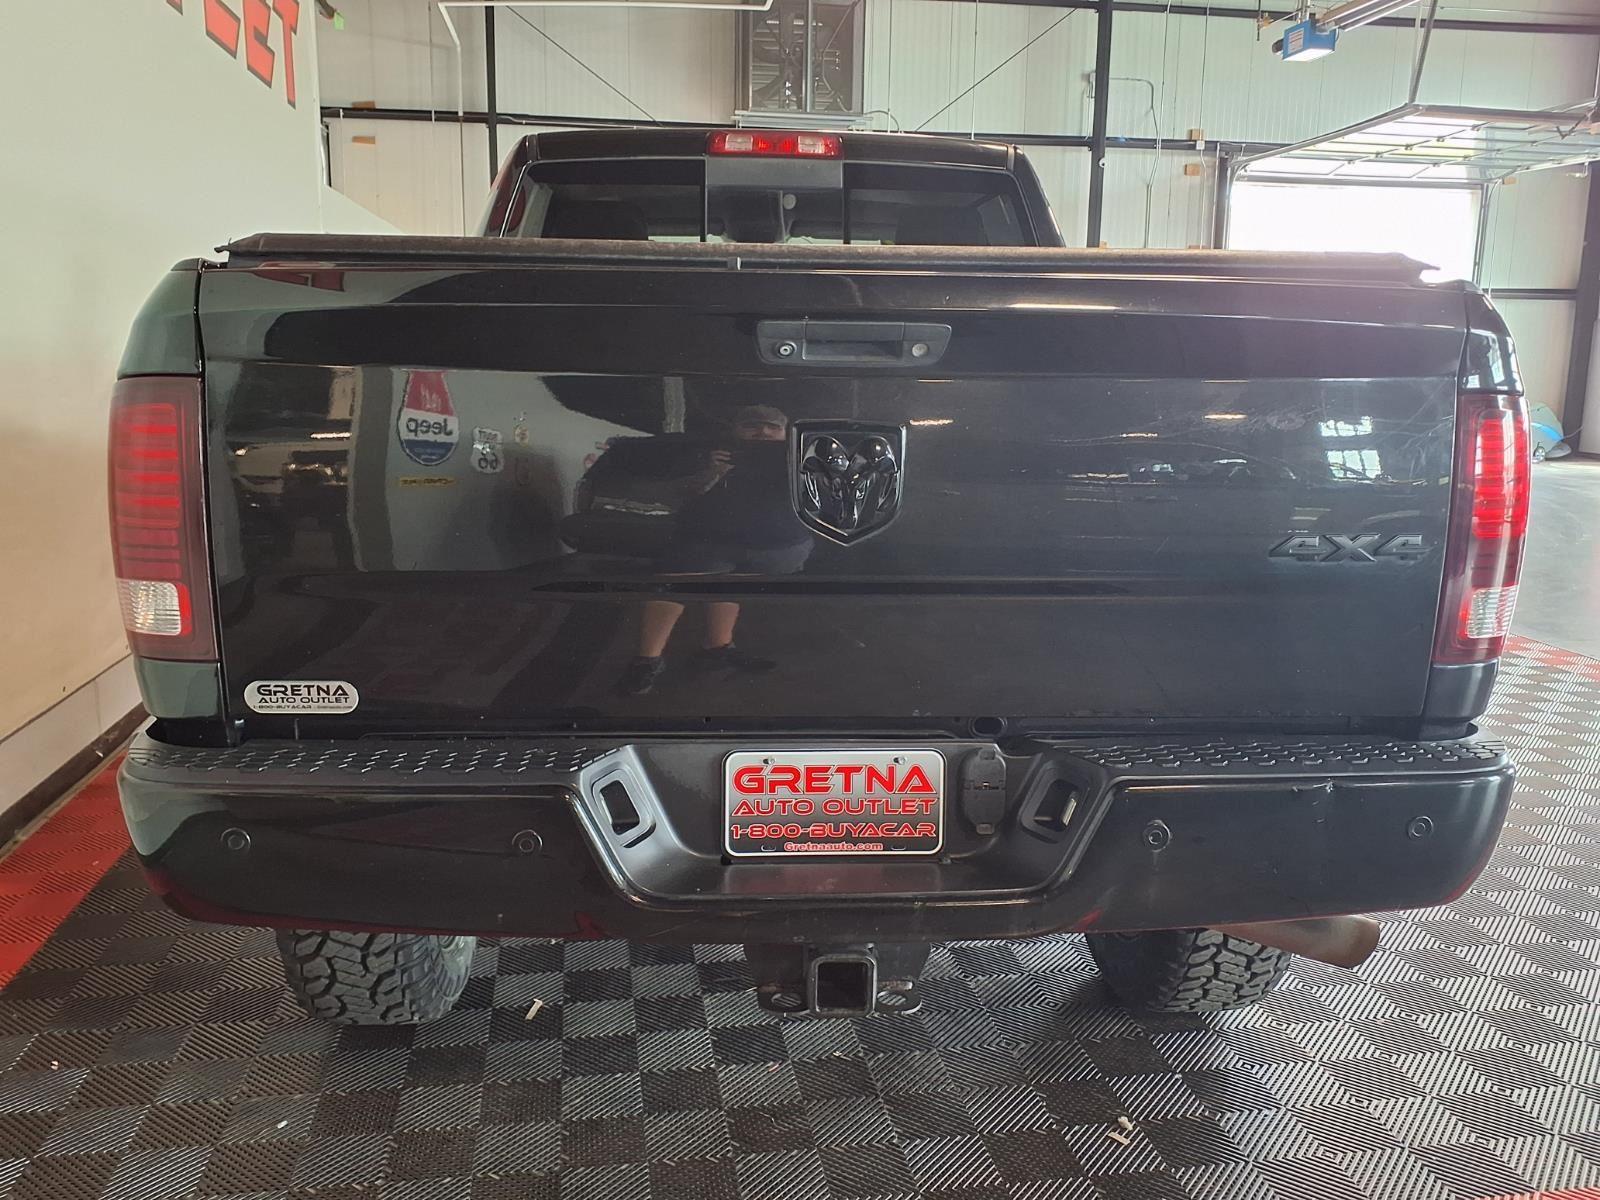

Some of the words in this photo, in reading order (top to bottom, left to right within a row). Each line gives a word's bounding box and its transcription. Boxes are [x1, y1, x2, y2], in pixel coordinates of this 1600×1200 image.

[168, 0, 300, 110] LET
[256, 684, 350, 697] GRETNA
[732, 764, 938, 795] GRETNA
[731, 799, 816, 816] AUTO
[822, 798, 938, 815] OUTLET
[730, 823, 937, 839] 1-800-BUYACAR
[783, 841, 884, 852] Gretnaauto.com
